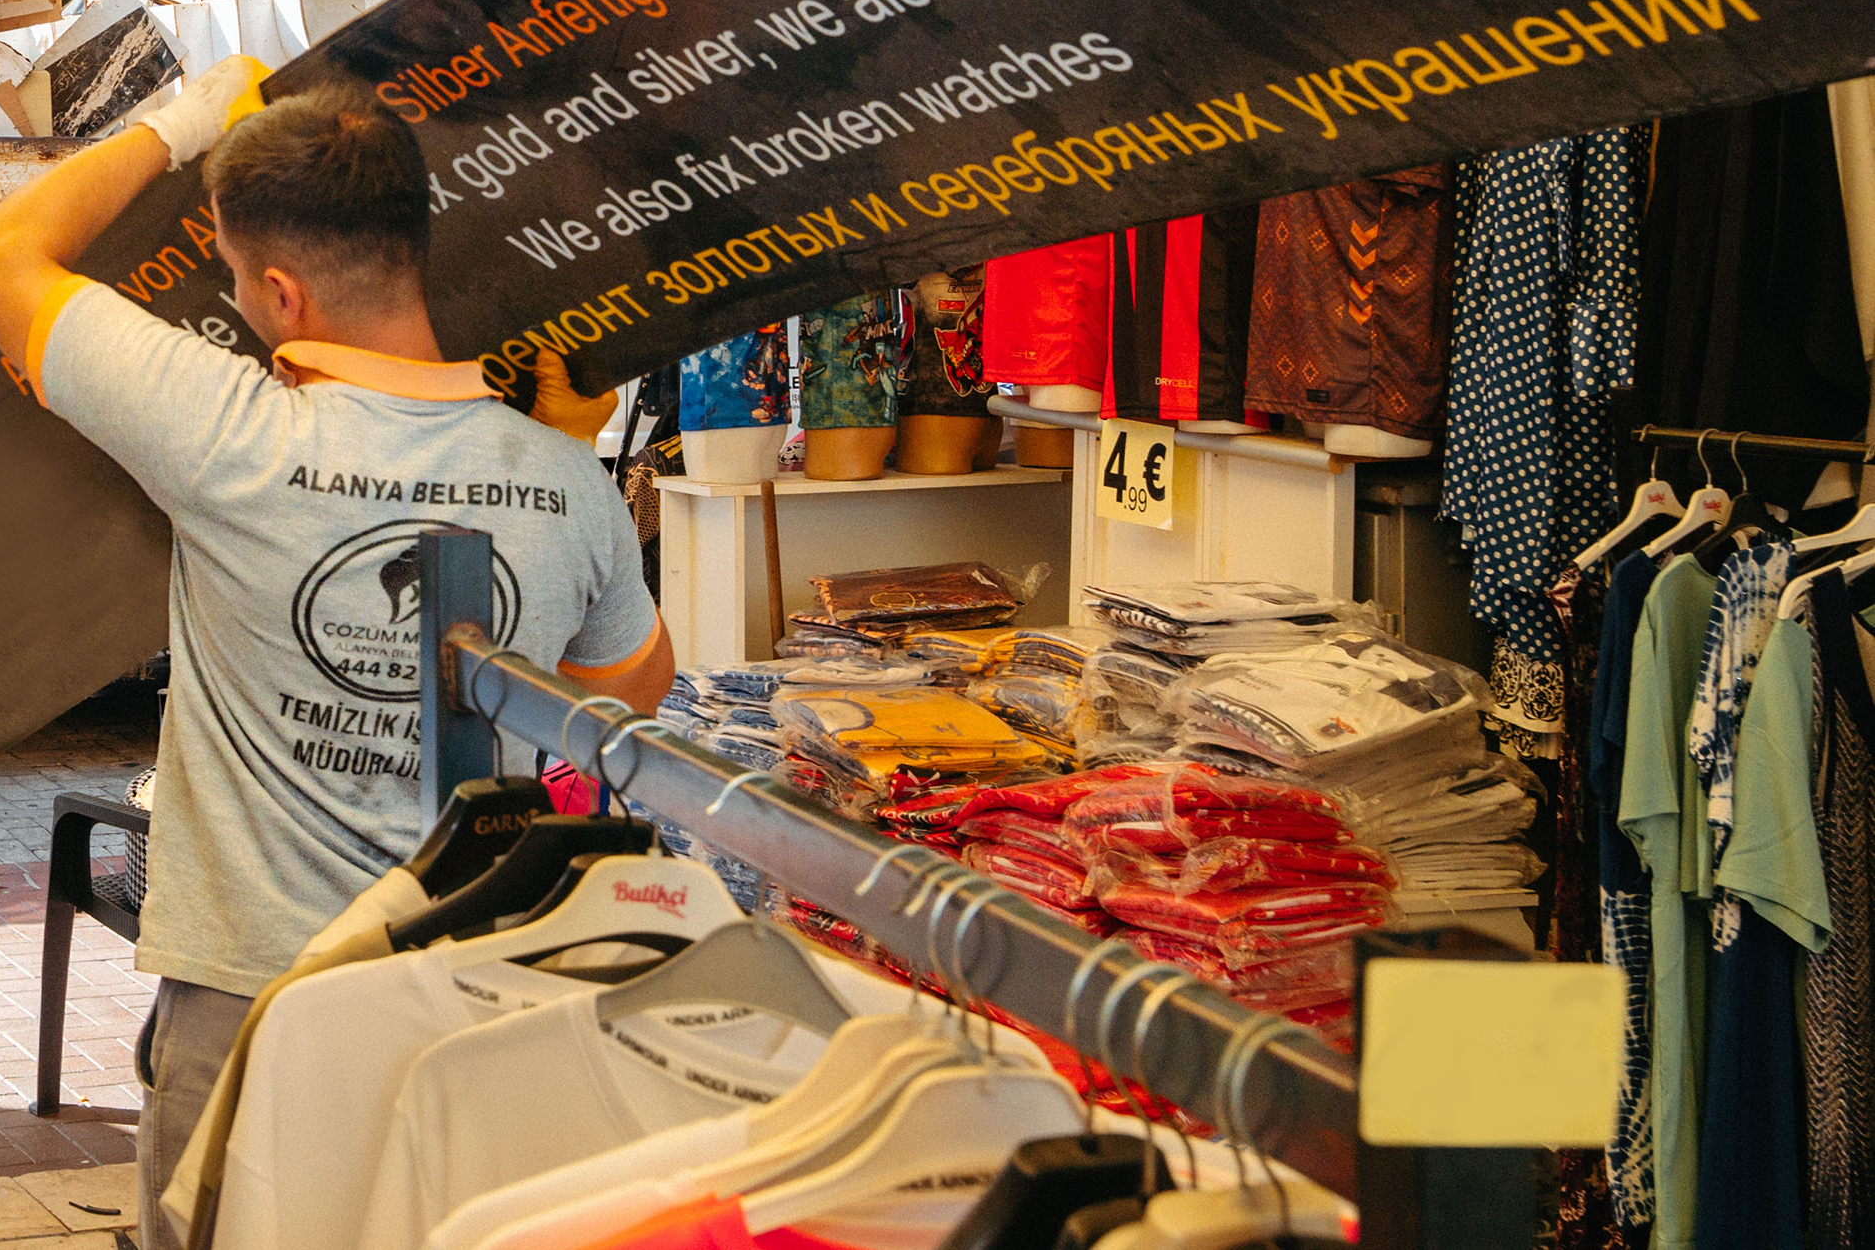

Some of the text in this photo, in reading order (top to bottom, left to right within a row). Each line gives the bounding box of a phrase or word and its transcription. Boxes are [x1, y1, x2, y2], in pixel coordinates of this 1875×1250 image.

[375, 44, 503, 124] Silber
[452, 113, 554, 199] gold
[543, 72, 640, 144] and
[505, 32, 1134, 270] We also fix broken watches
[477, 283, 651, 398] ремонт
[645, 205, 866, 305] золотых
[850, 192, 909, 233] и
[899, 91, 1284, 218] серебряных
[1154, 377, 1194, 388] DRYCELL
[287, 465, 568, 517] ALANYA BELEDİYESİ
[335, 658, 381, 677] 444
[278, 692, 400, 738] TEMİZLİK
